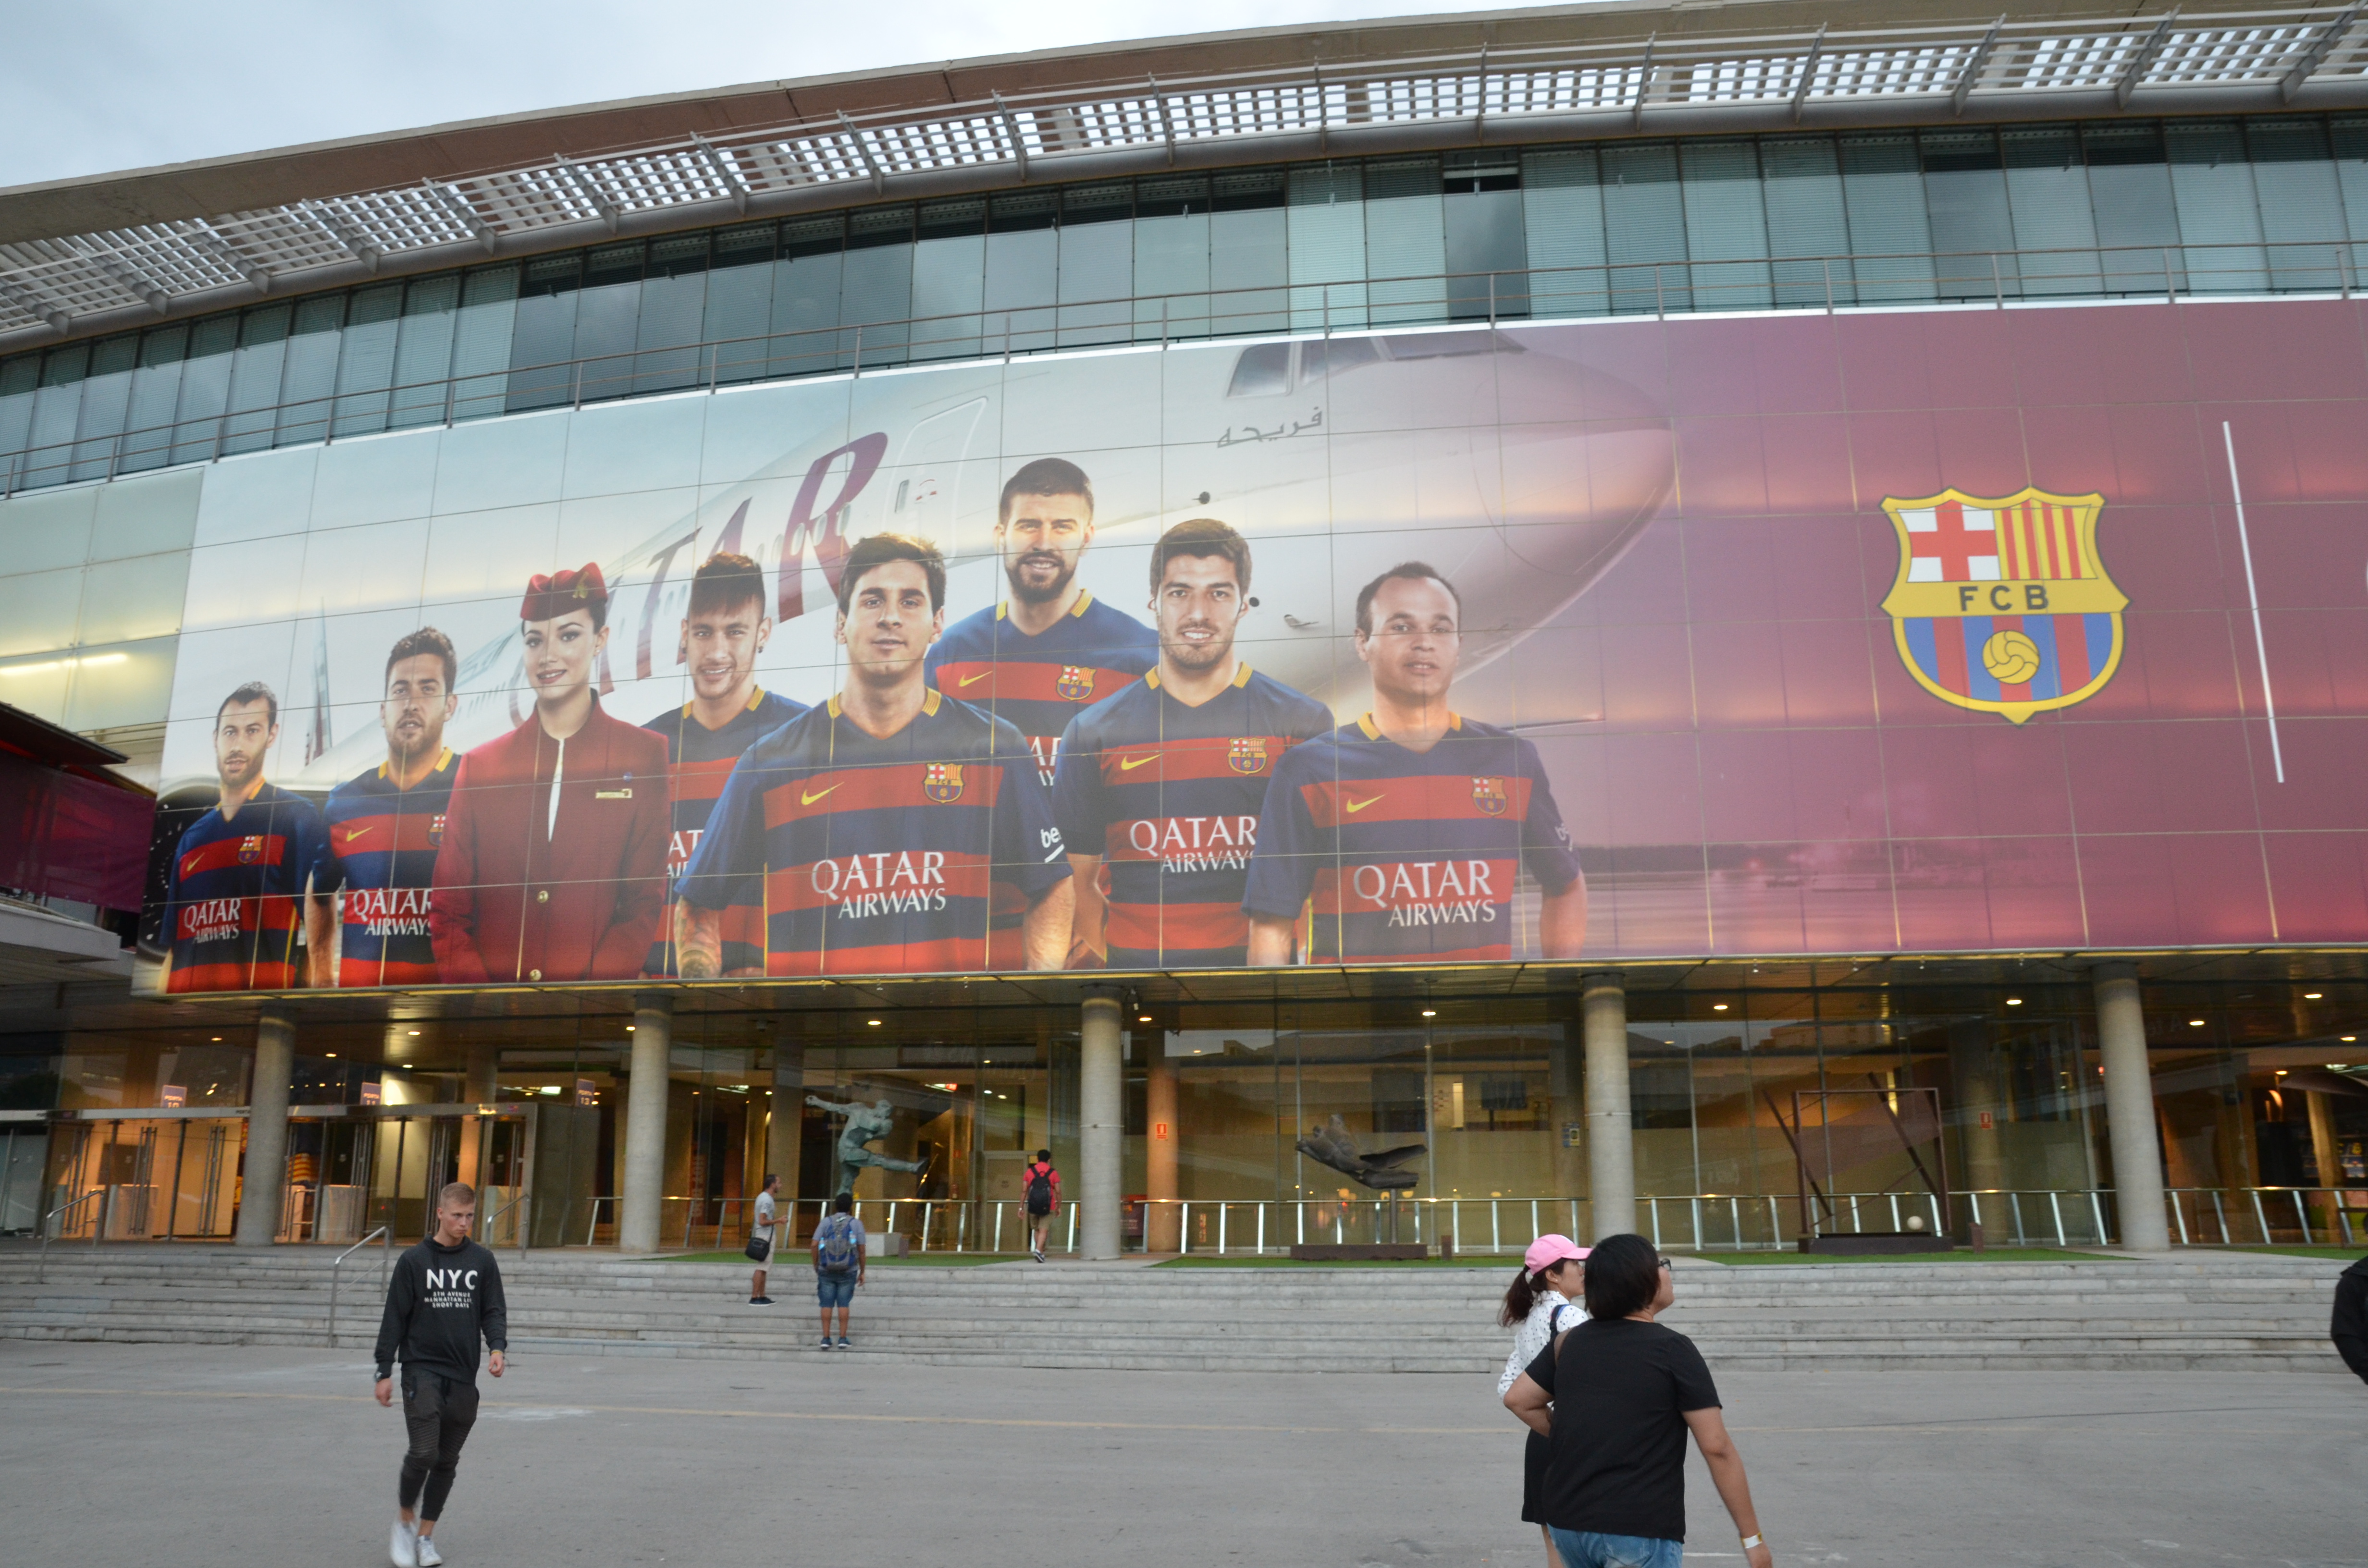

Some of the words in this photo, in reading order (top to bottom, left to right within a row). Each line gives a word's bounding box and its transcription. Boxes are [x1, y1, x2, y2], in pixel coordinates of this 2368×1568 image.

[1958, 585, 2049, 612] FCB
[1130, 816, 1257, 858] QATAR
[811, 851, 945, 901] QATAR
[1353, 860, 1493, 908] QATAR
[184, 898, 241, 932] QATAR
[838, 888, 947, 919] AIRWAYS
[1388, 899, 1496, 928] AIRWAYS
[193, 923, 240, 944] AIRWAYS
[426, 1268, 478, 1290] NYC
